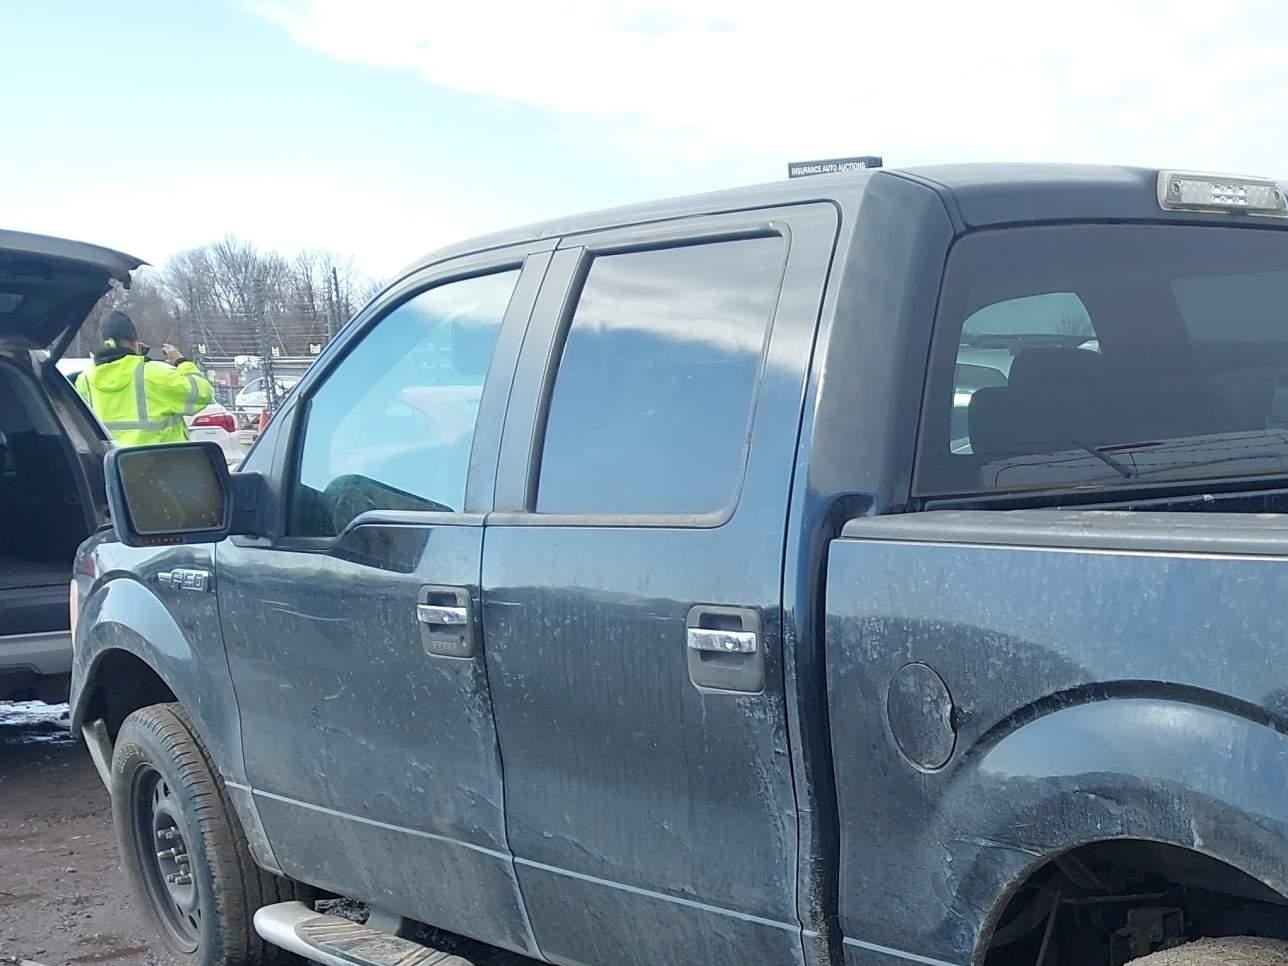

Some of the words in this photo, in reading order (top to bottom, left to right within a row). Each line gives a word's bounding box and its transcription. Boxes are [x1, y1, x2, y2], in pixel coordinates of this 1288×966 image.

[791, 165, 822, 176] INSURANCE
[822, 163, 837, 173] AUTO
[838, 161, 866, 172] AUCTIONS
